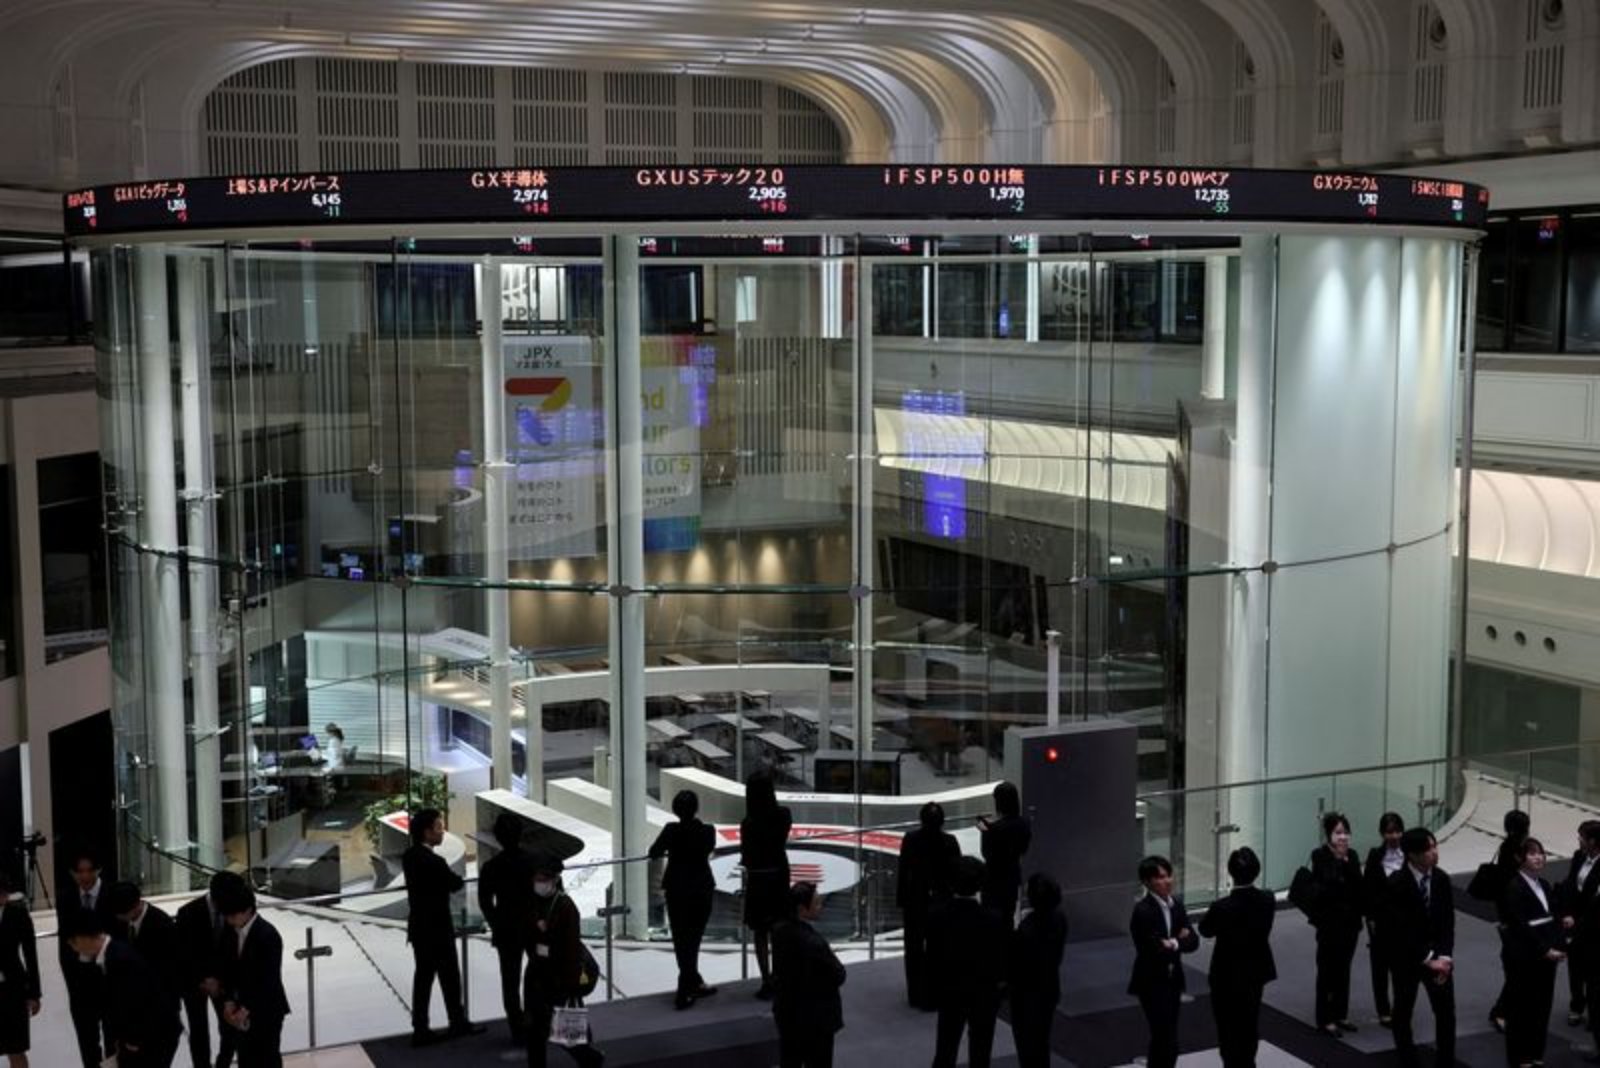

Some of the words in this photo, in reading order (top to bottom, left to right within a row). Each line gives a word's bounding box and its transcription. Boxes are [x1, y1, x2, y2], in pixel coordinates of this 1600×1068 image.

[471, 170, 548, 188] GX半導体
[636, 168, 784, 186] GXUSテック20
[1313, 174, 1379, 191] GXウラニウム
[311, 193, 341, 207] 6,145
[513, 188, 548, 203] 2,974
[749, 187, 786, 201] 2,905
[989, 187, 1024, 201] 1,970
[1194, 189, 1230, 202] 12,735
[524, 202, 549, 215] +14
[761, 200, 786, 213] +16
[1010, 201, 1024, 212] -2
[523, 346, 553, 359] JPX
